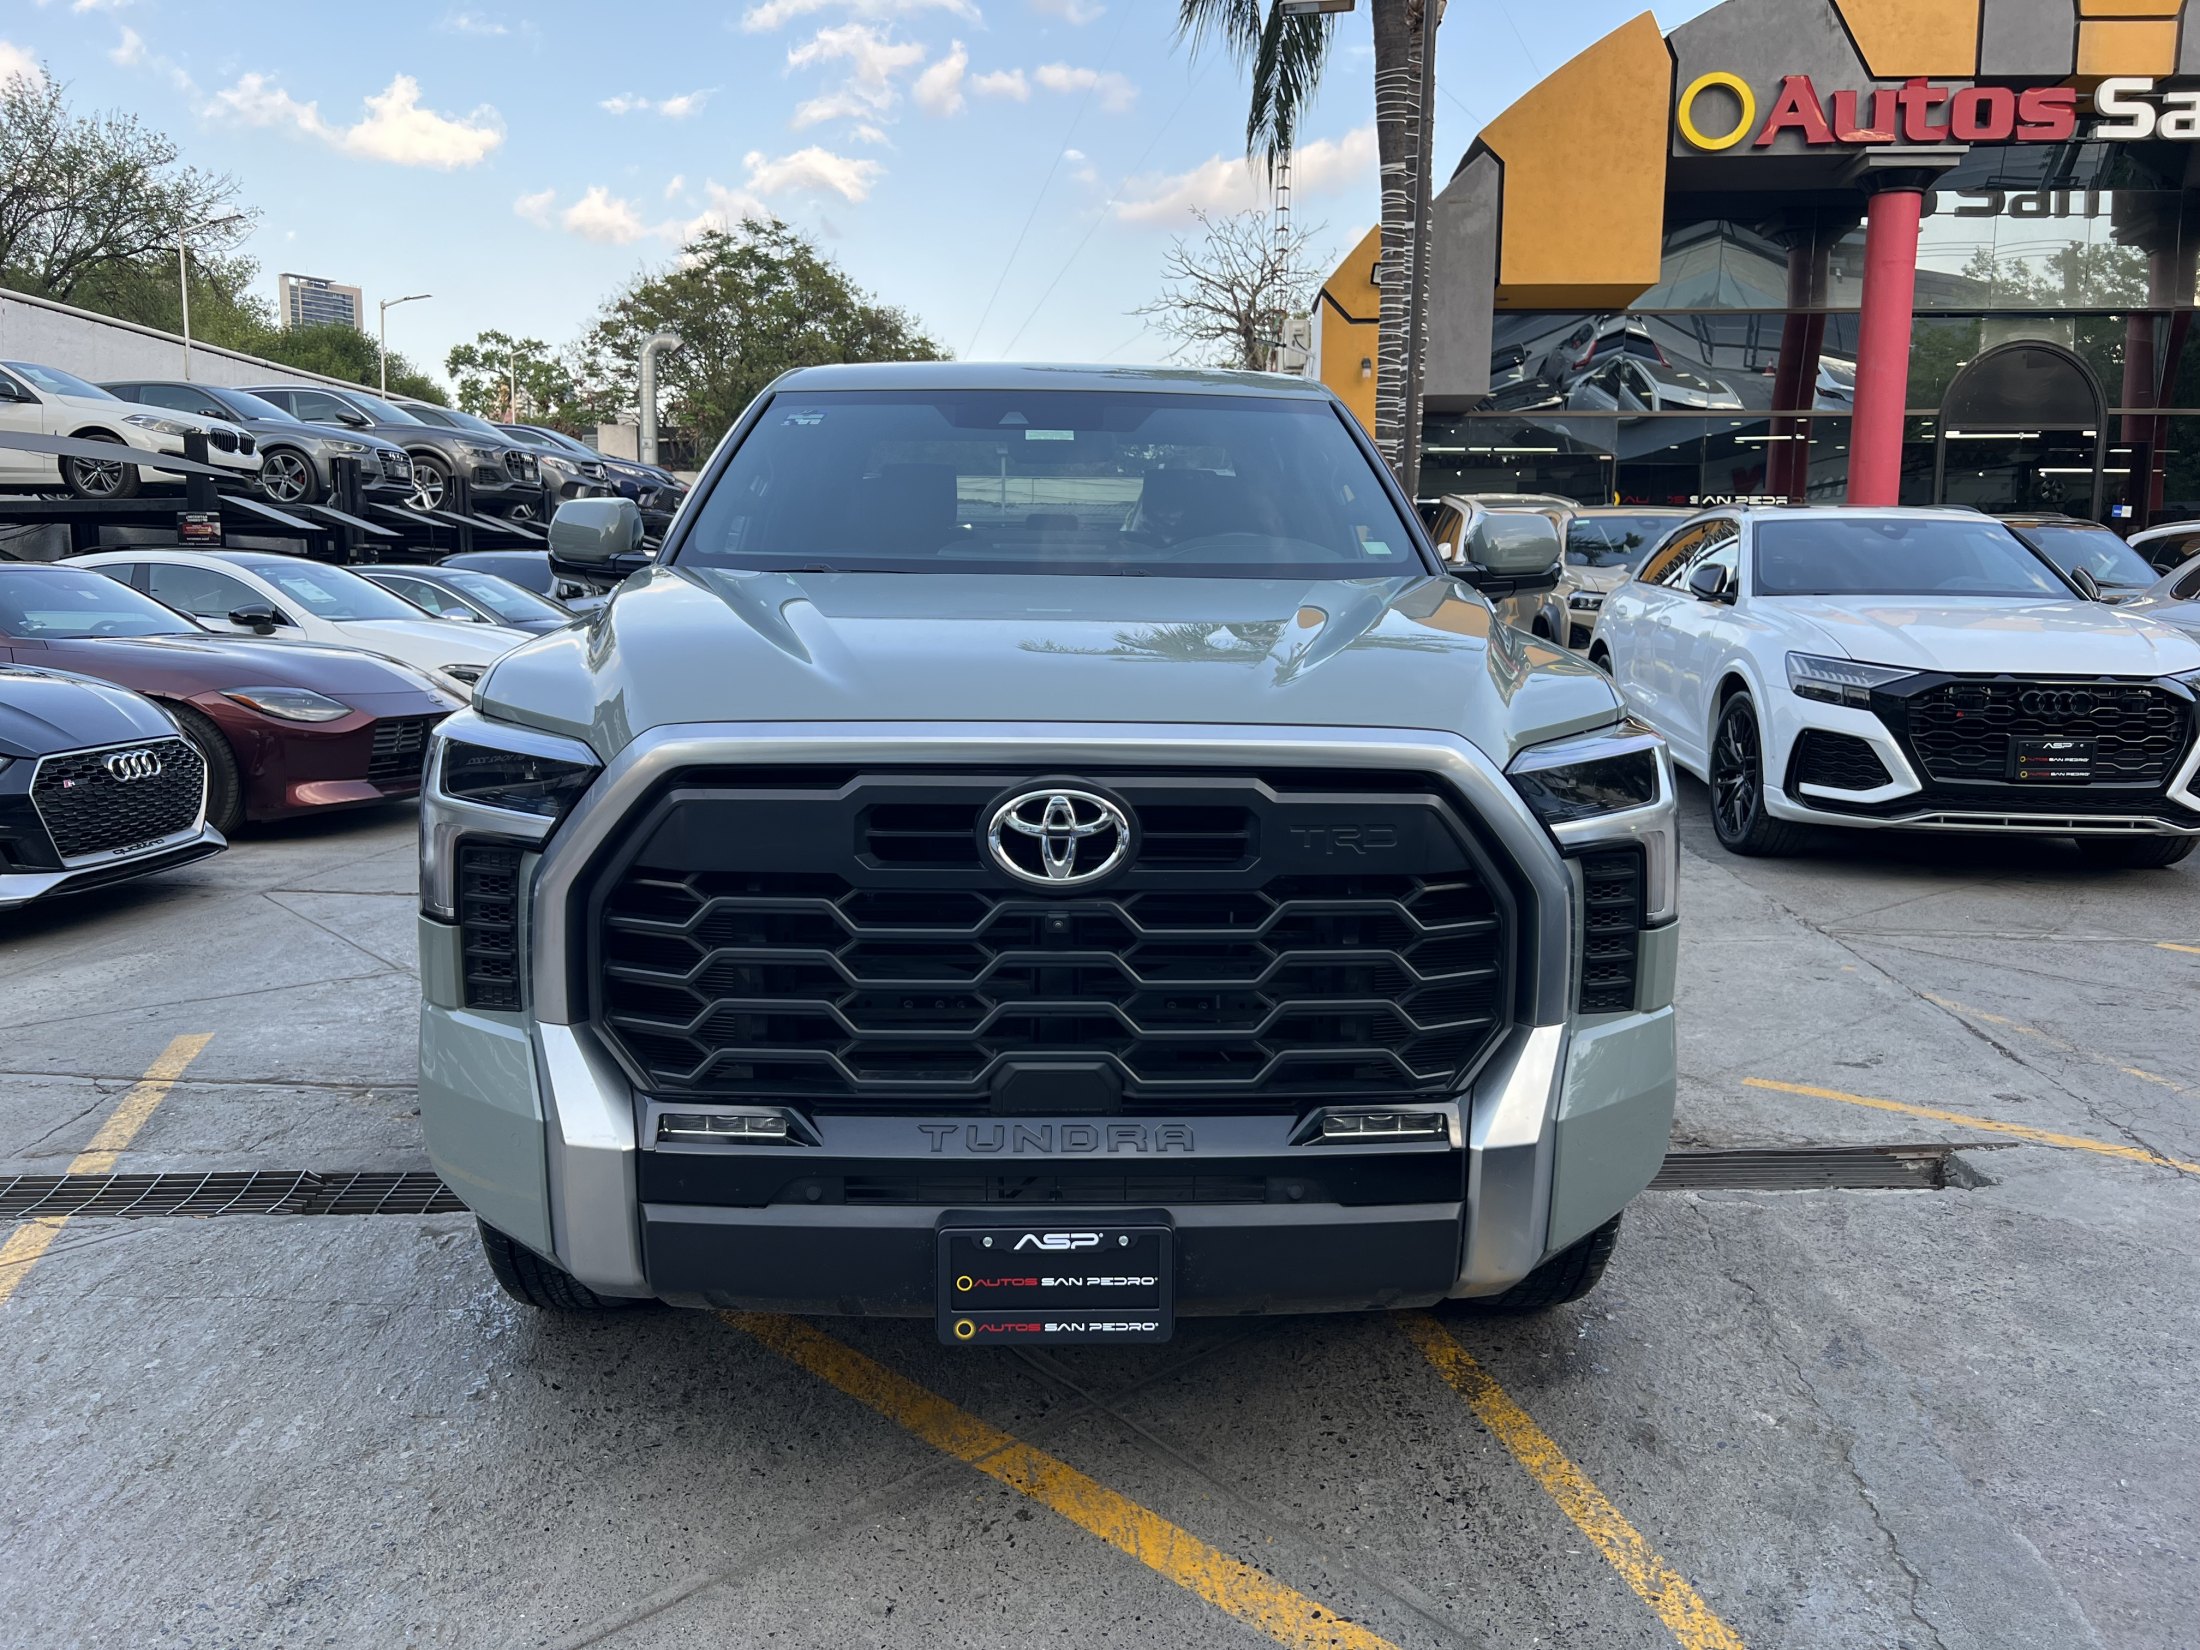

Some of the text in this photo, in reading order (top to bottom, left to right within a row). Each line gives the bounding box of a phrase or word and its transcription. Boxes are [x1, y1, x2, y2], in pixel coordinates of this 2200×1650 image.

[1754, 75, 2200, 145] Autos Sa
[1289, 824, 1398, 855] TRD
[917, 1124, 1195, 1153] TUNDRA
[1013, 1232, 1103, 1250] ASP
[974, 1277, 1158, 1288] AUTOS SAN PEDRO
[978, 1322, 1158, 1333] AUTOS SAN PEDRO
